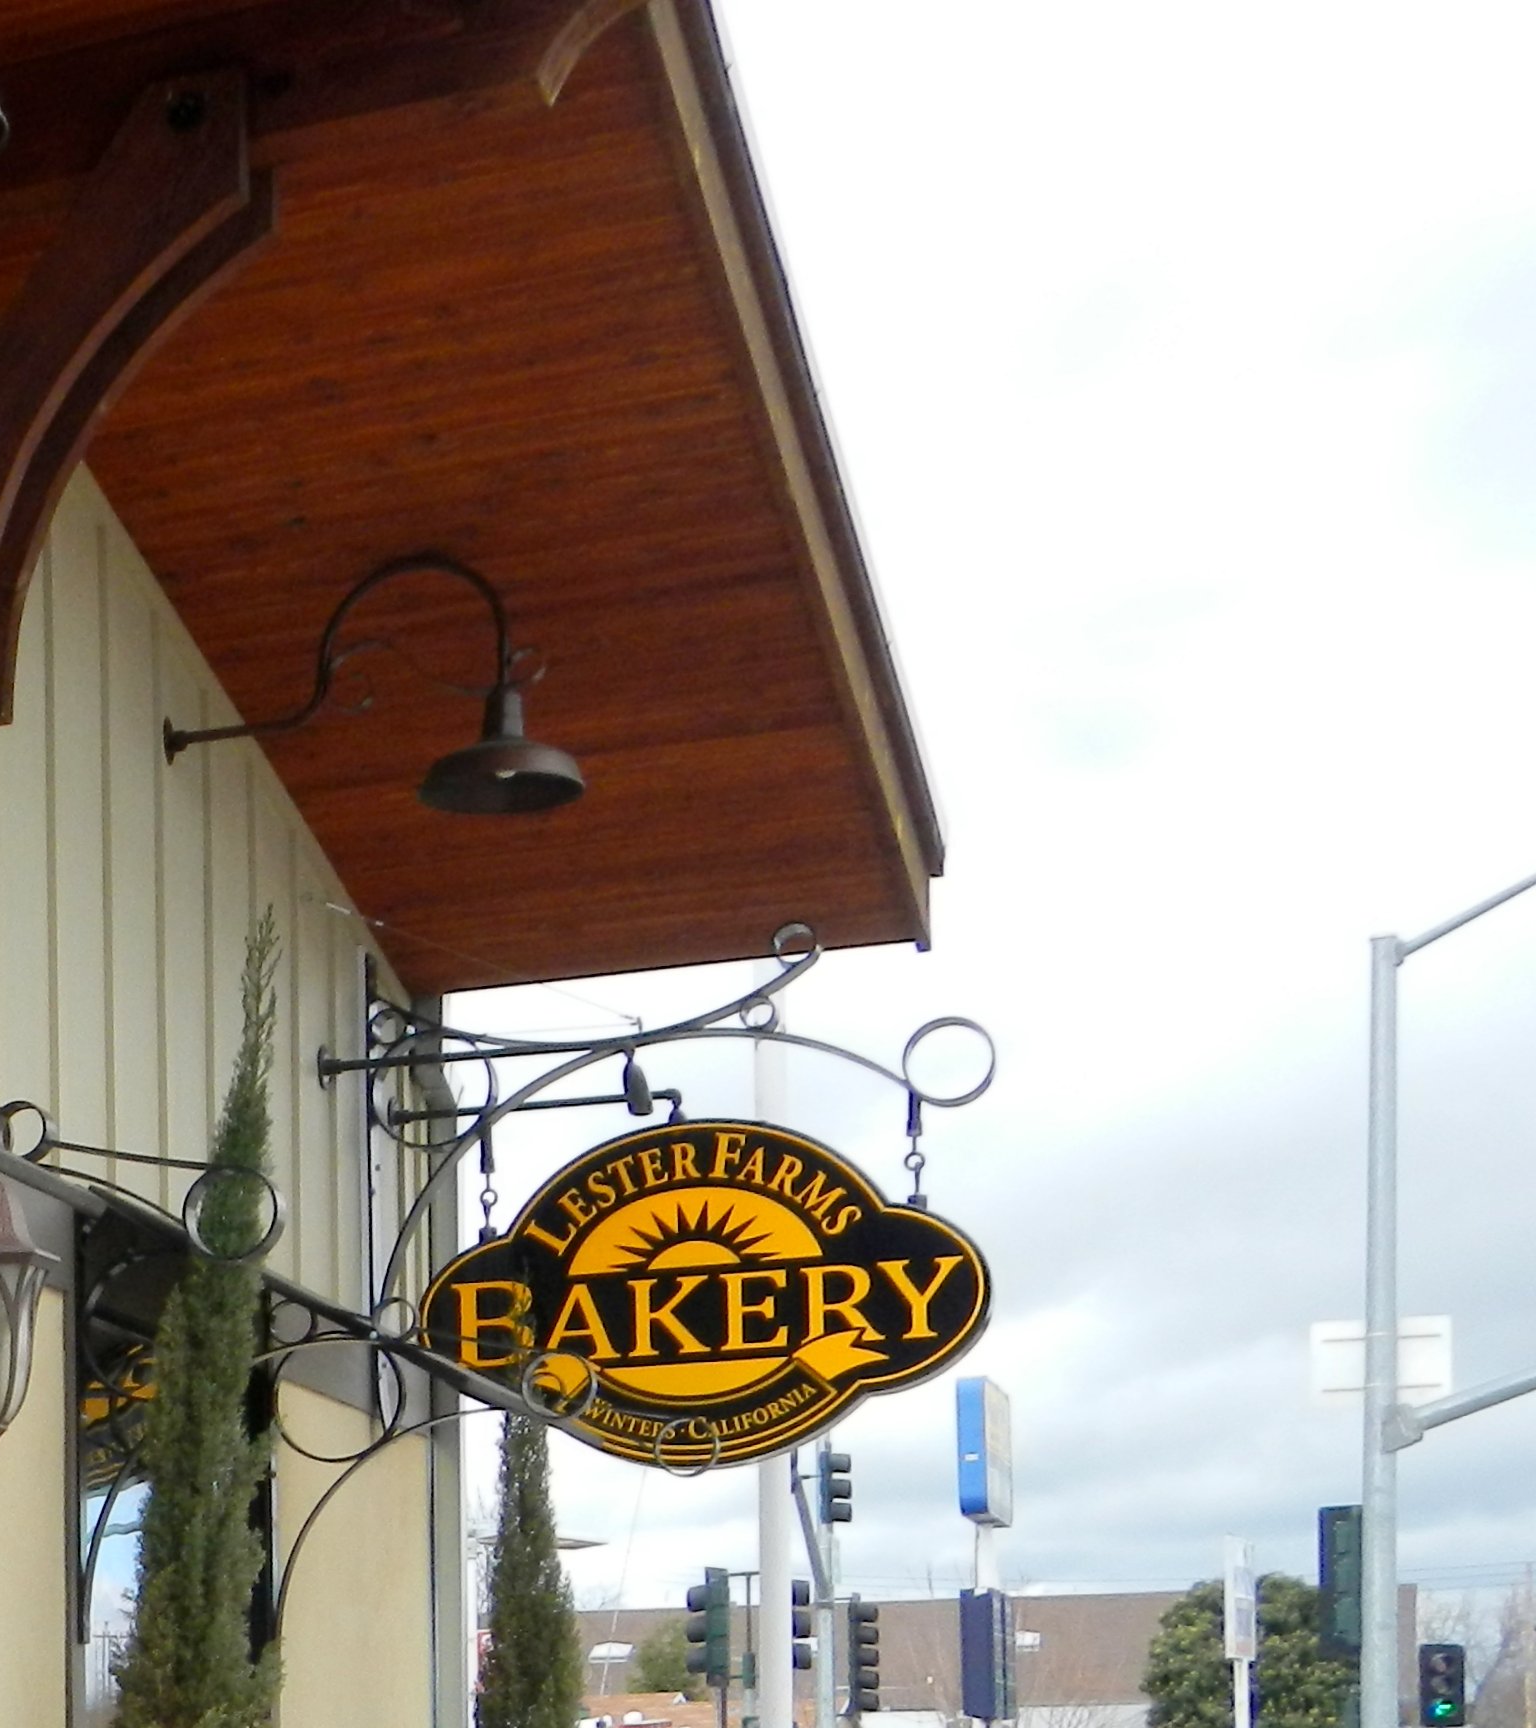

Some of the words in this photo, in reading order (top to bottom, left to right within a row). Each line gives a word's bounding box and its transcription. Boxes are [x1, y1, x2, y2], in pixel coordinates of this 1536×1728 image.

[524, 1142, 698, 1258] LESTER
[709, 1131, 863, 1238] FARMS
[451, 1254, 965, 1369] BAKERY
[688, 1382, 818, 1439] CALIFORNIA
